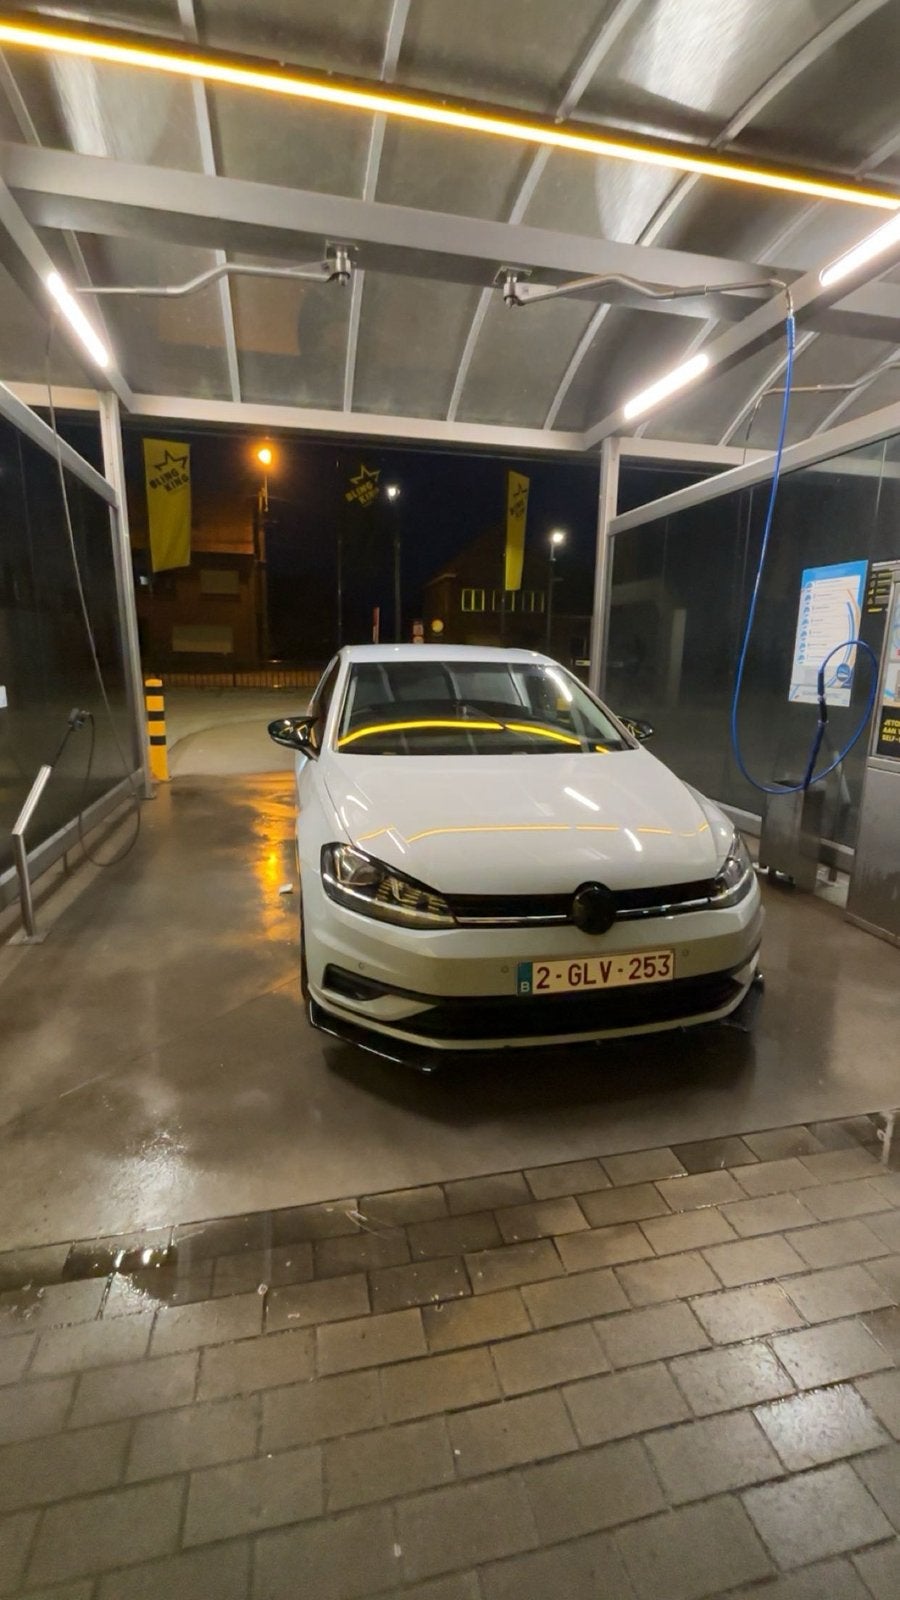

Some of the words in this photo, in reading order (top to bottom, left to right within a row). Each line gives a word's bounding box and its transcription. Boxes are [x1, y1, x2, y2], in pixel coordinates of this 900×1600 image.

[149, 467, 180, 490] BLING
[164, 473, 189, 493] KING
[344, 481, 374, 503] BLING
[536, 954, 671, 990] 2-GLV-253
[520, 981, 530, 993] B
